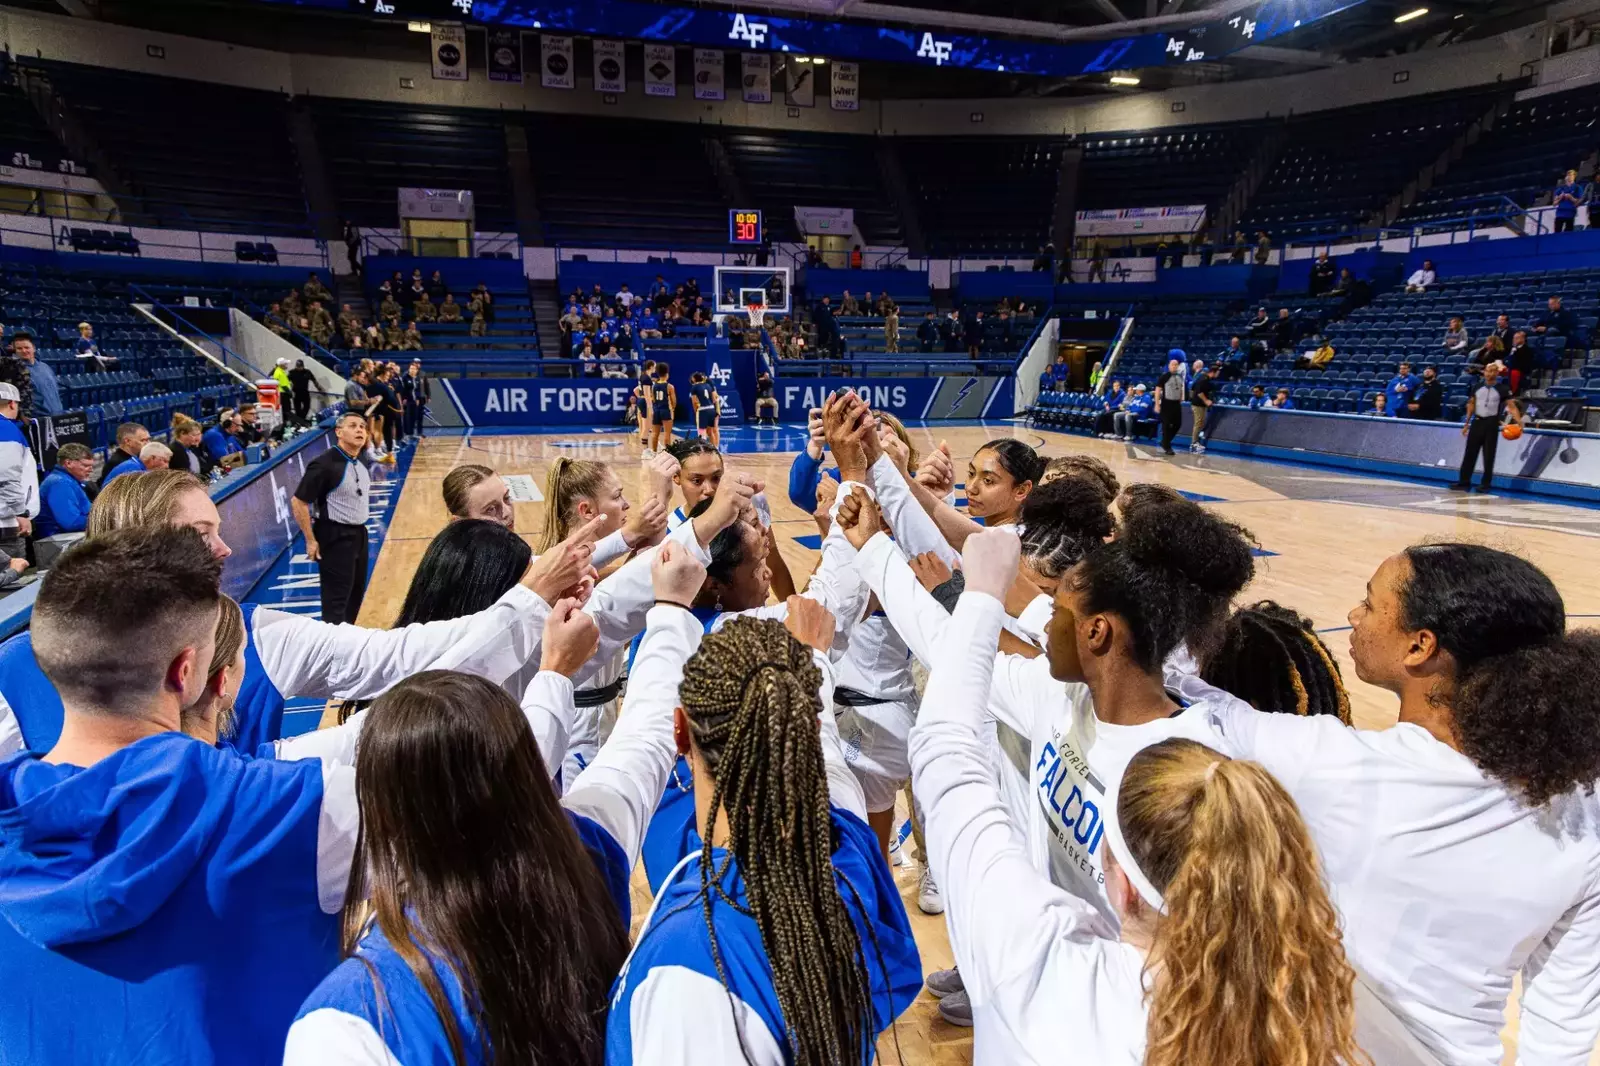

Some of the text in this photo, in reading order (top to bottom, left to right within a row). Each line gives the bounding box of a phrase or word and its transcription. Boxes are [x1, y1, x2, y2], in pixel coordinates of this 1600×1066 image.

[728, 13, 768, 49] AF
[916, 32, 953, 66] AF
[1166, 37, 1185, 56] AF
[736, 213, 757, 224] 10:00
[737, 223, 755, 240] 30
[709, 362, 732, 386] AF
[484, 387, 629, 412] AIR FORCE
[784, 385, 907, 409] FALONS
[55, 423, 85, 436] SPACE FORCE
[1060, 743, 1089, 776] FORCE
